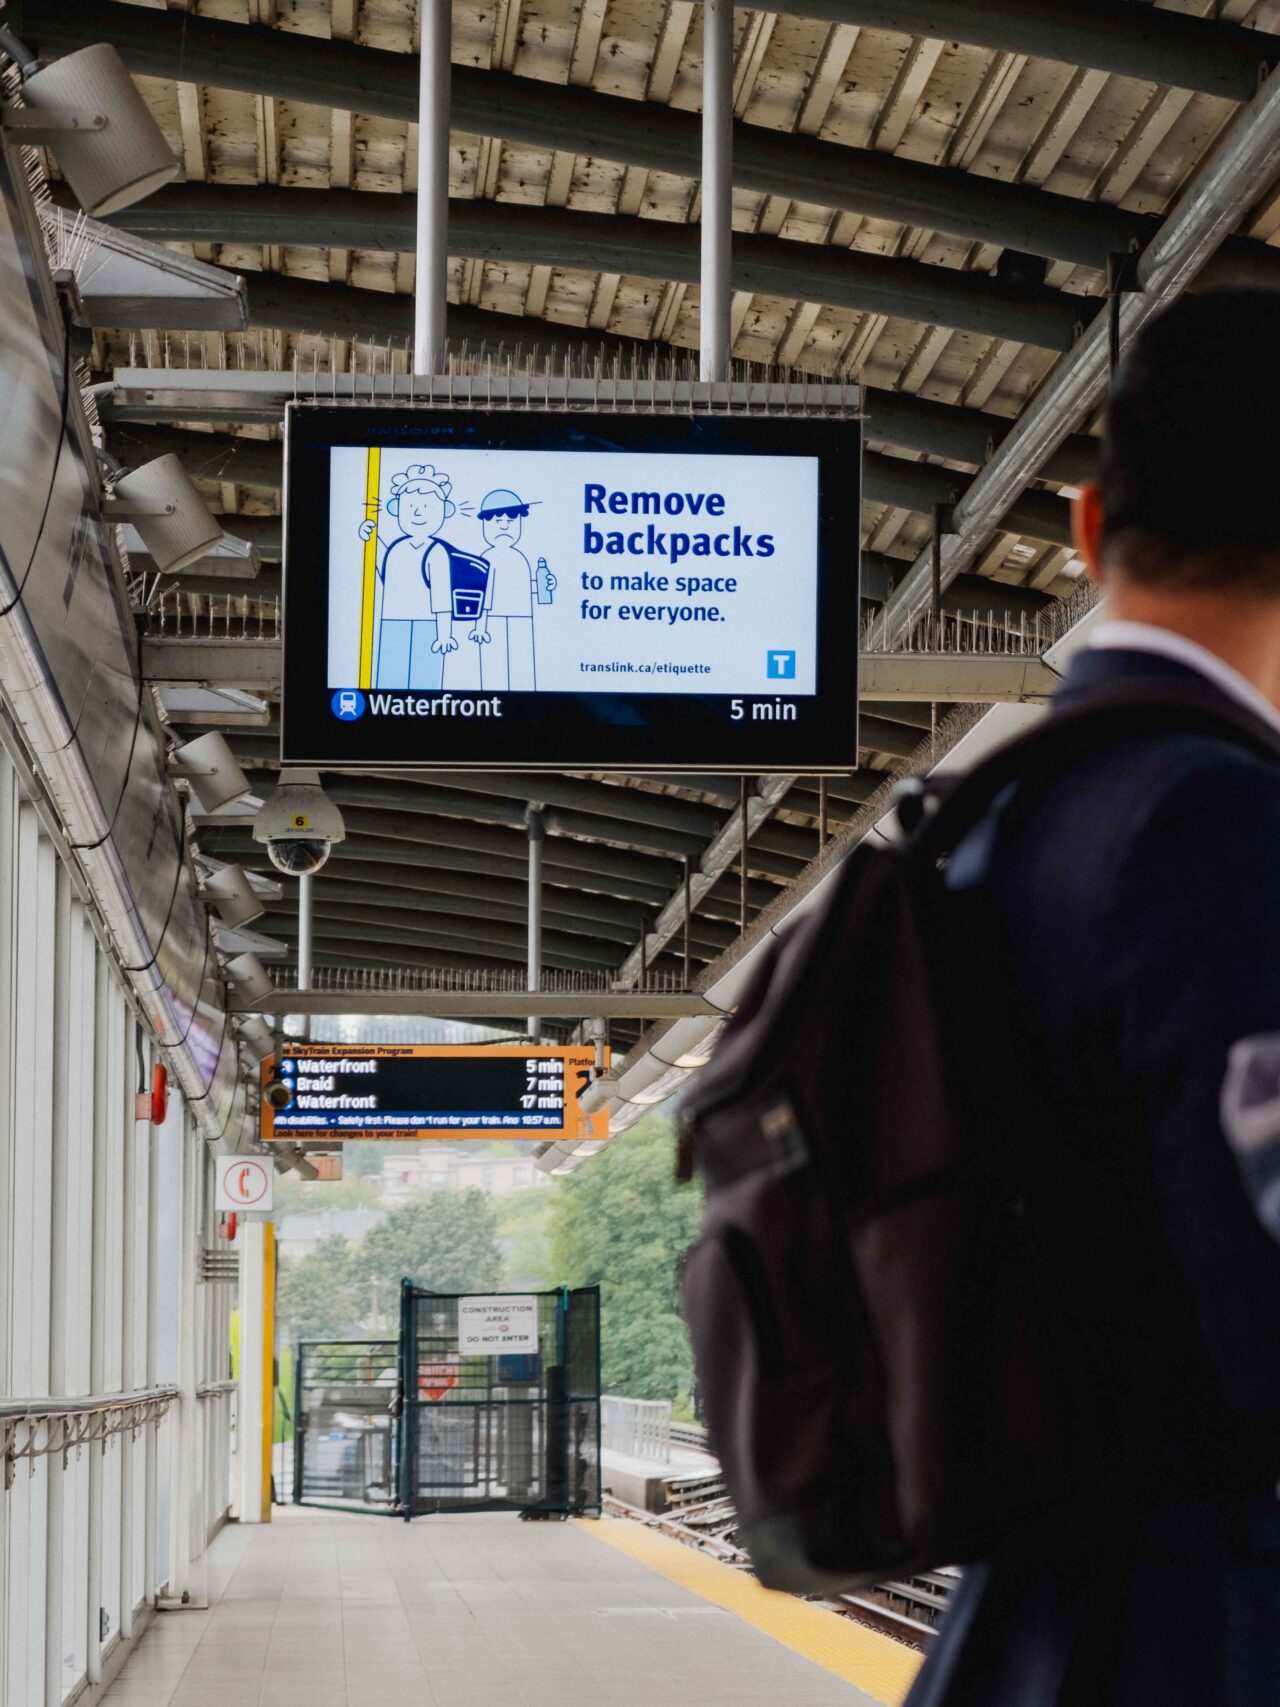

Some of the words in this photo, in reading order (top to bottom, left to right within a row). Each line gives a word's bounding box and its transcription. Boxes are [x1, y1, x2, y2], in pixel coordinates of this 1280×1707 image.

[583, 483, 725, 516] Remove
[583, 522, 775, 564] backpacks
[581, 571, 603, 590] to
[610, 571, 669, 592] make
[675, 576, 737, 596] space
[581, 599, 611, 620] for
[618, 605, 725, 625] everyone.
[580, 662, 711, 676] translink.ca/etiquette
[368, 693, 502, 717] Waterfront
[730, 699, 744, 720] 5
[752, 698, 797, 720] min
[295, 816, 305, 827] 6
[293, 1047, 329, 1055] SkyTrain
[332, 1047, 375, 1055] Expansion
[377, 1047, 413, 1055] Program
[297, 1059, 377, 1073] Waterfront
[526, 1059, 537, 1073] 5
[538, 1059, 563, 1073] min
[569, 1058, 595, 1066] Platfor
[297, 1076, 334, 1091] Braid
[526, 1077, 537, 1091] 7
[538, 1077, 563, 1091] min
[297, 1095, 377, 1109] Waterfront
[520, 1095, 537, 1109] 17
[538, 1094, 563, 1108] min
[273, 1129, 292, 1137] Look
[295, 1129, 313, 1137] here
[315, 1129, 328, 1137] for
[330, 1129, 363, 1139] changes
[376, 1131, 395, 1139] your
[396, 1129, 418, 1137] train!
[462, 1306, 533, 1314] CONSTRUCTION
